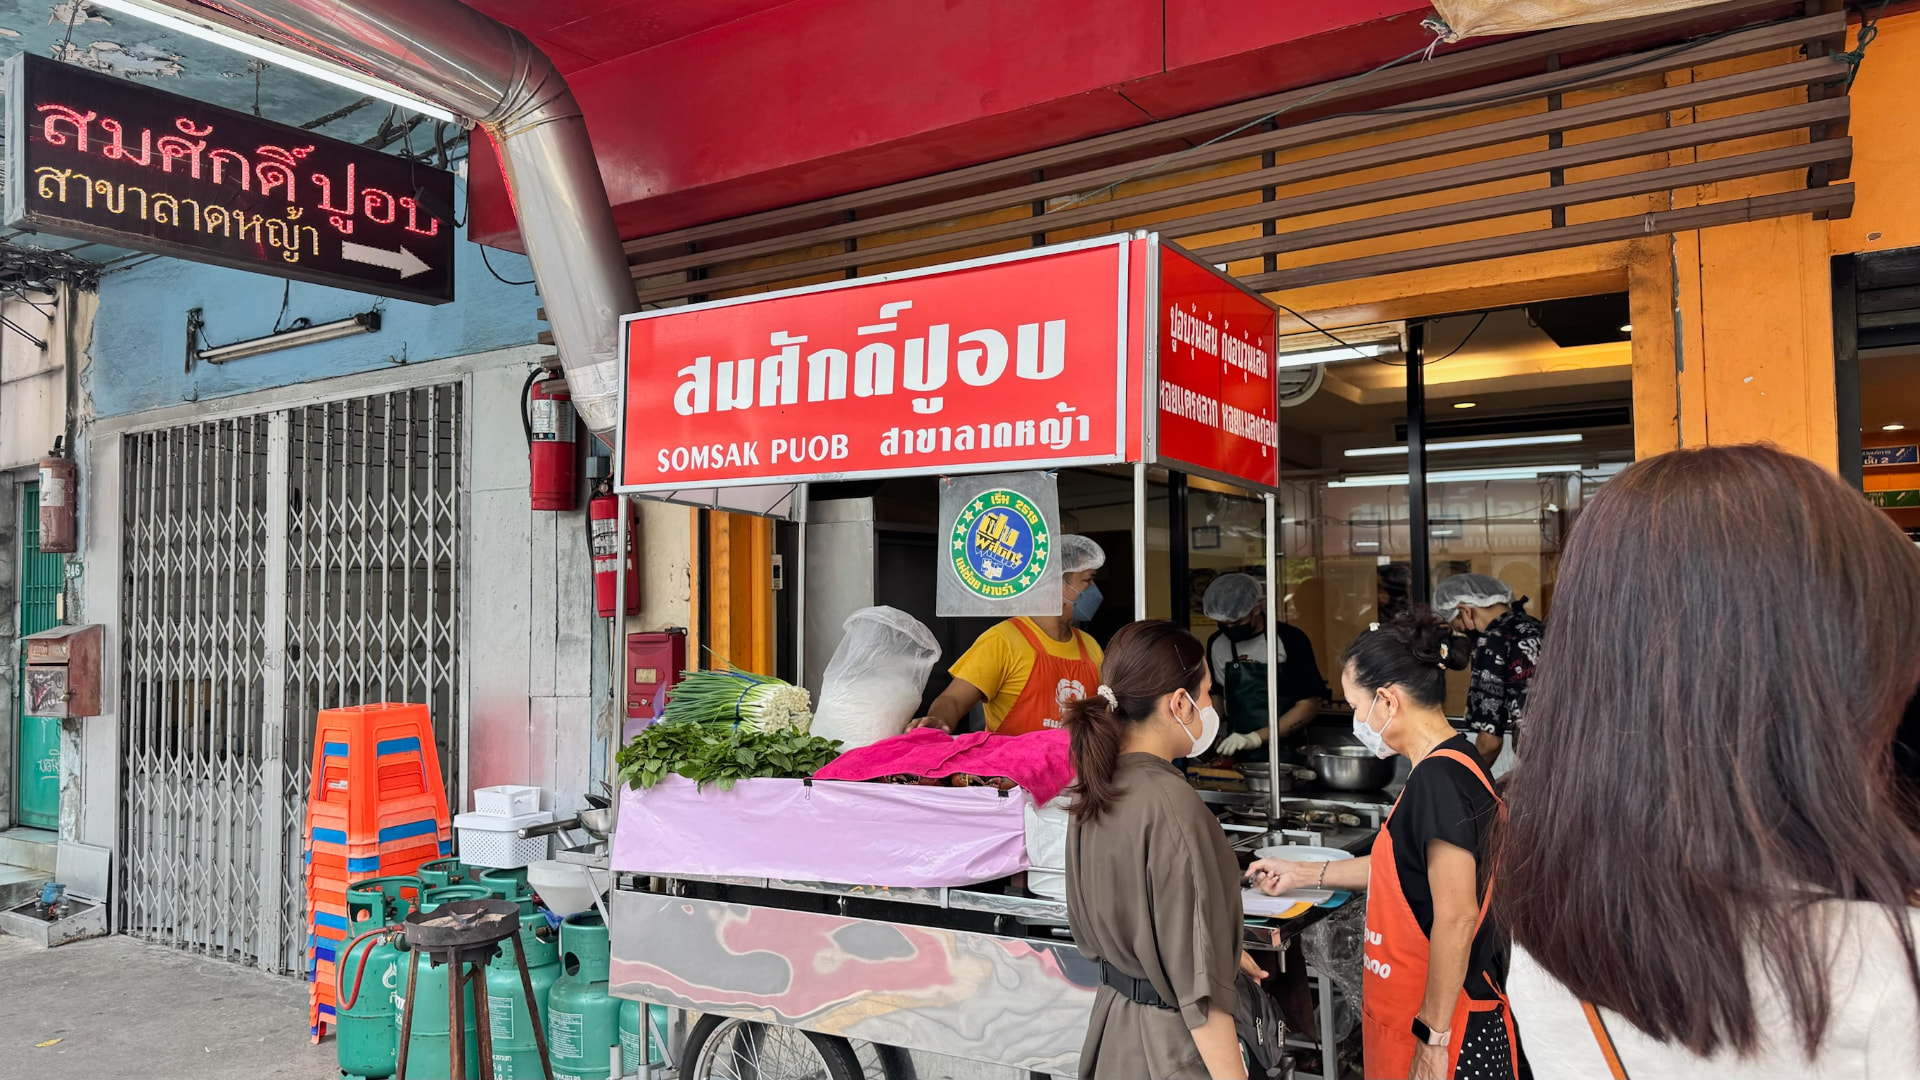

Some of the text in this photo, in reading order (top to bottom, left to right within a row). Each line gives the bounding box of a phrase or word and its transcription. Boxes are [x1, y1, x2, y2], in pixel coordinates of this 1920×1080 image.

[34, 166, 320, 263] สาขาลาดหญ้า
[673, 299, 1066, 416] สมศักดิ์ปูอบ
[1169, 302, 1268, 384] ปูอบวุ้นเส้น กุ้งอบวุ้นเส้น
[879, 400, 1090, 457] สาขาลาดหญ้า
[1159, 379, 1219, 429] หอยแครงลวก
[656, 433, 850, 474] SOMSAK PUOB
[1014, 499, 1039, 525] 2519
